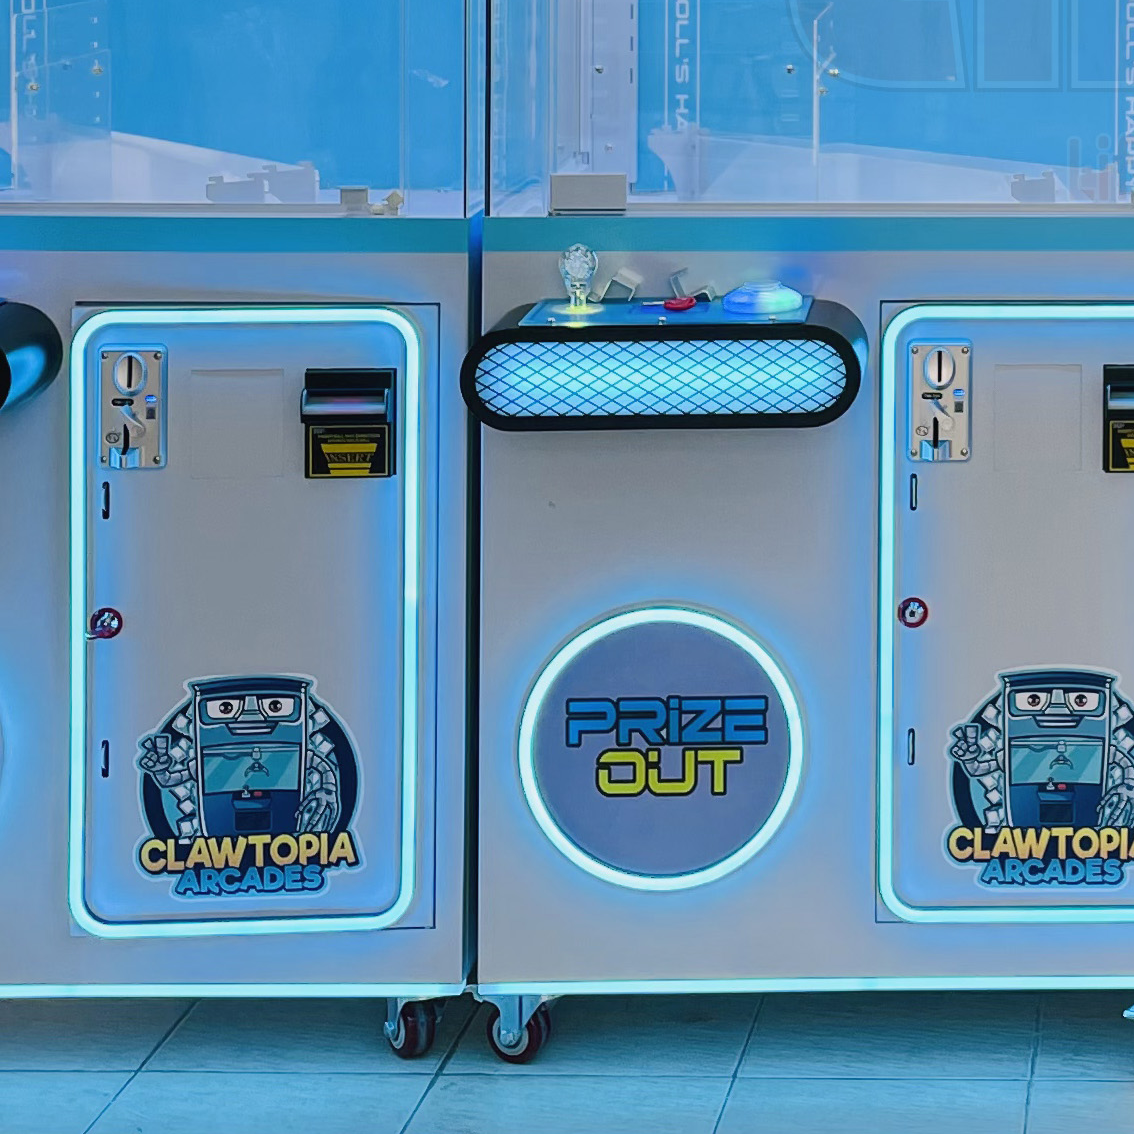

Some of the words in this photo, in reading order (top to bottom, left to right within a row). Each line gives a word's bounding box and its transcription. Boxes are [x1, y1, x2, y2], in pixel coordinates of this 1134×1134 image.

[325, 452, 374, 463] INSERT
[596, 747, 743, 797] OUT
[139, 832, 359, 873] CLAWTOPIA
[175, 864, 324, 895] ARCADES
[981, 858, 1123, 885] ARCADES
